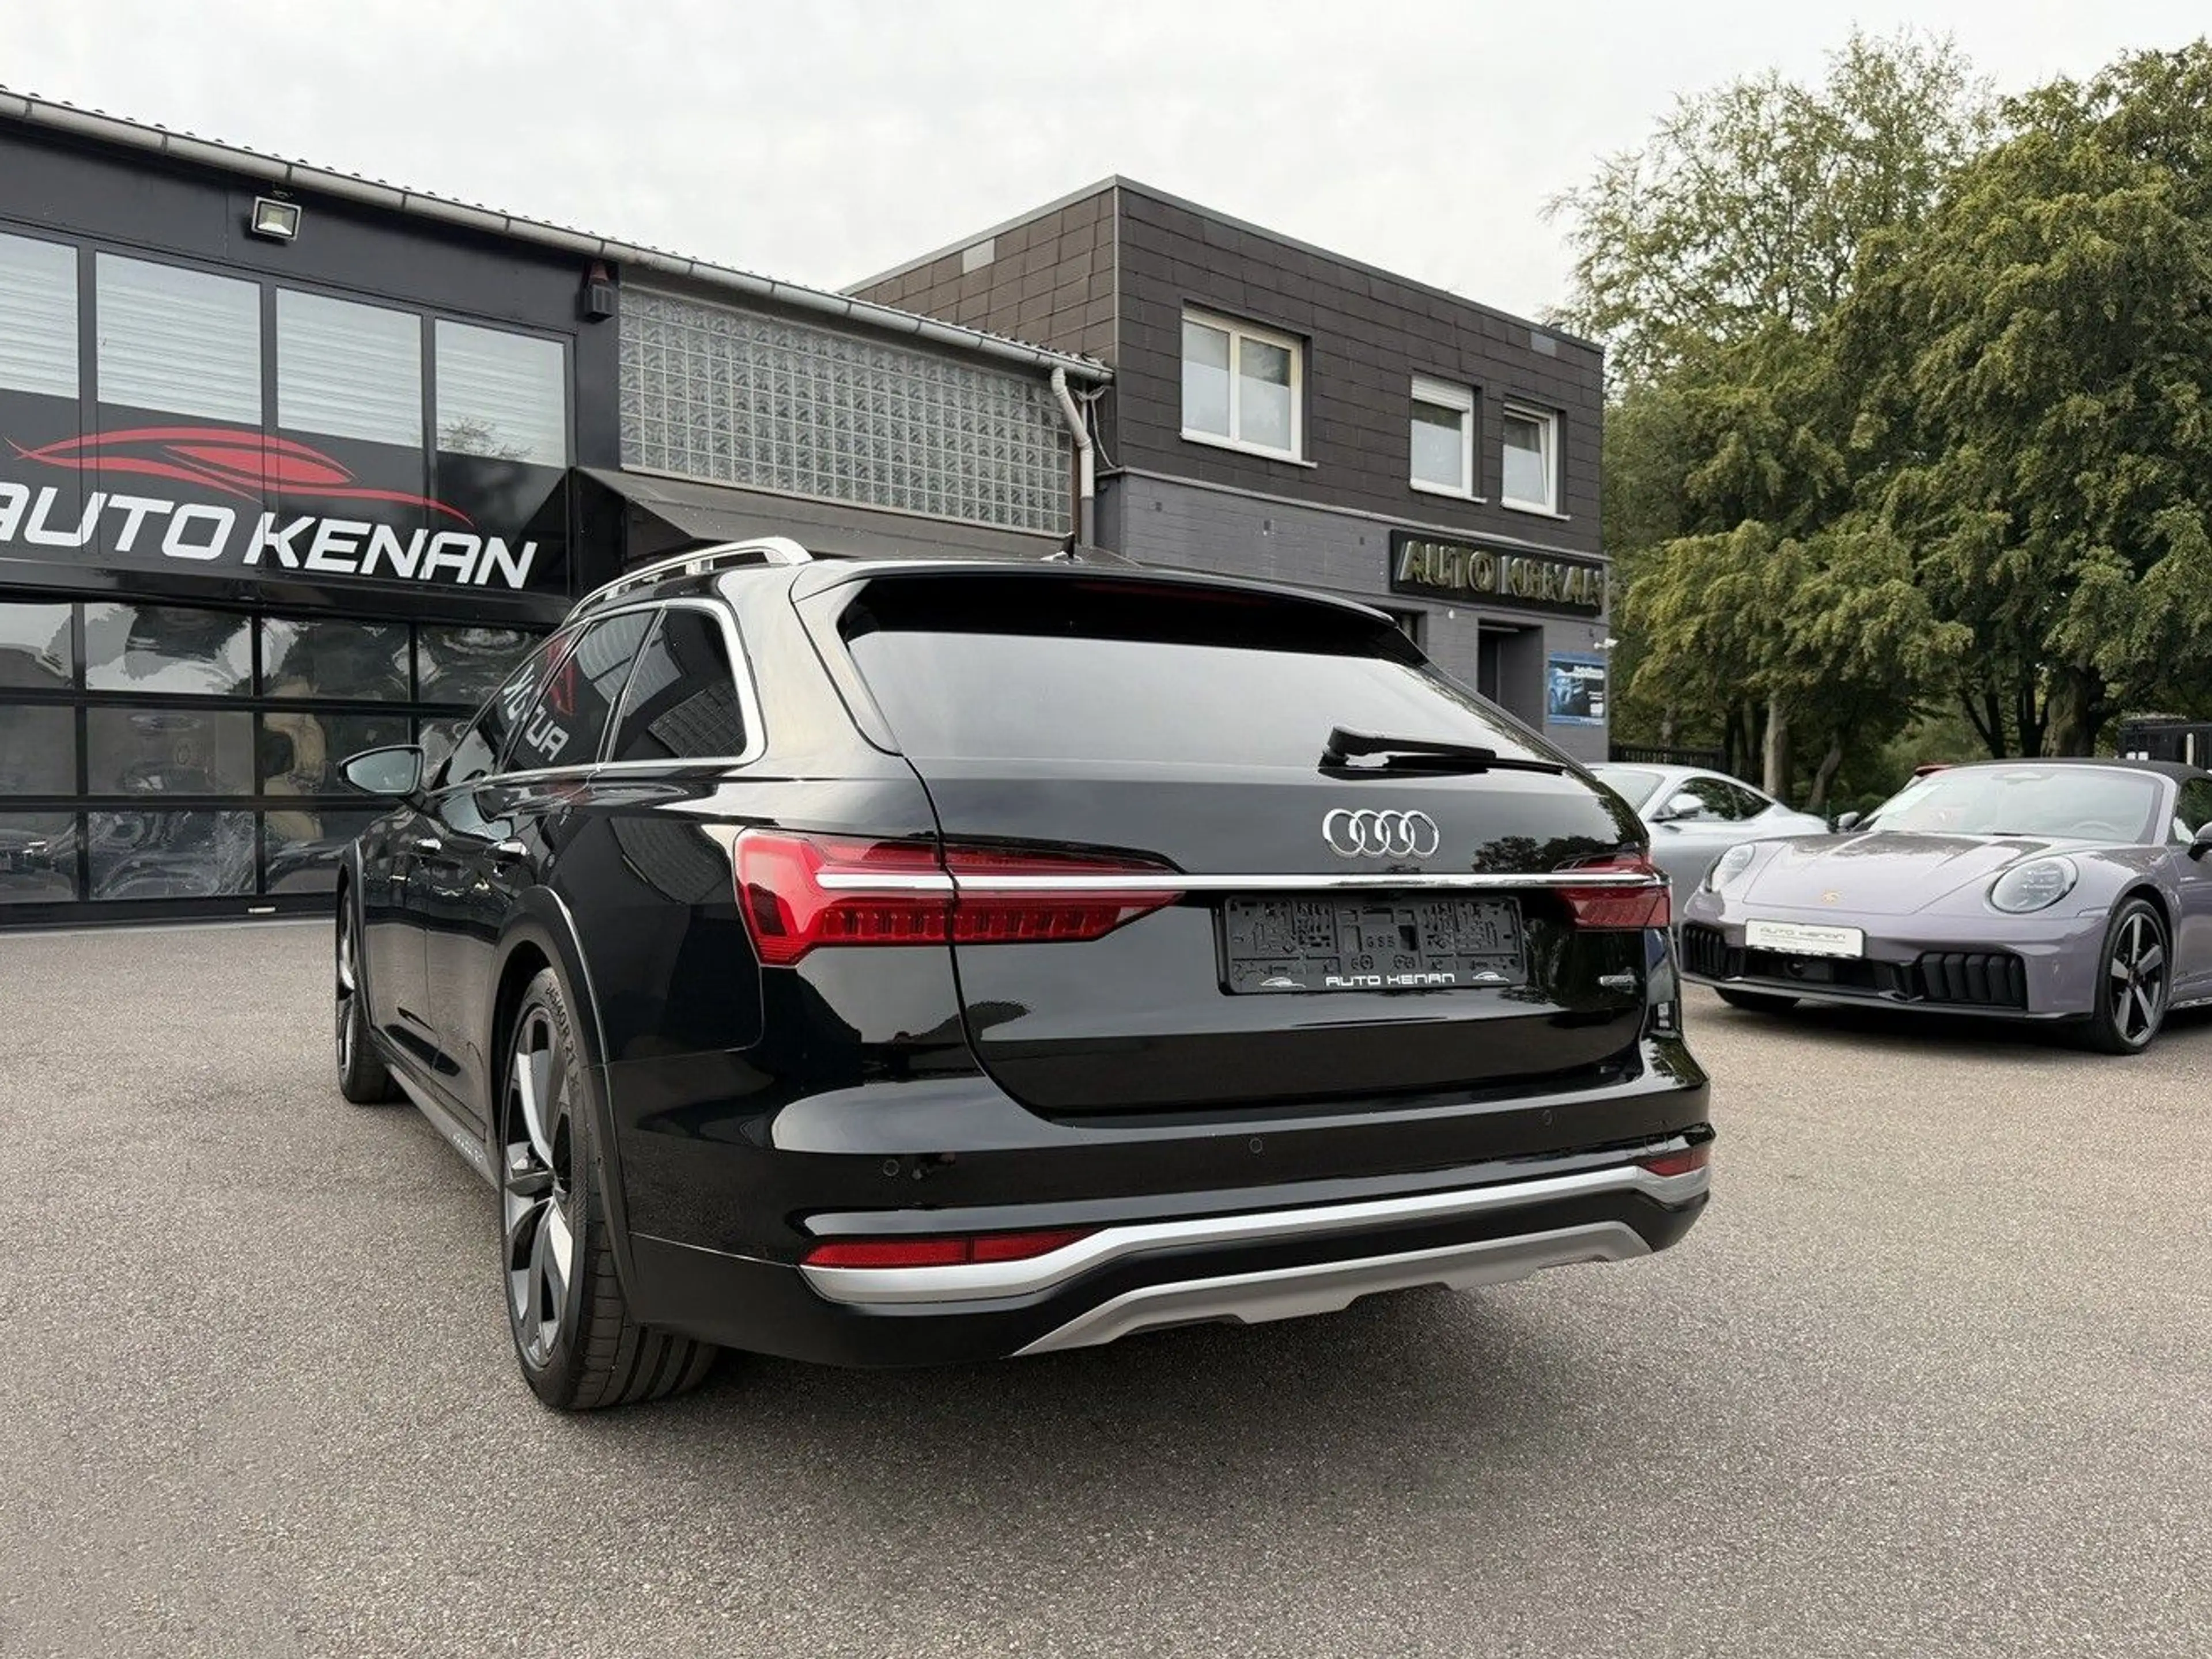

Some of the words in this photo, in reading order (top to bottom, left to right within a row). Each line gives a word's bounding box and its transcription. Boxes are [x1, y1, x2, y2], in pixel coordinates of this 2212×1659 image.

[243, 512, 538, 589] KENAN
[1400, 540, 1496, 593] AUTO
[1326, 975, 1381, 986] AUTO
[1387, 973, 1455, 984] KENAN
